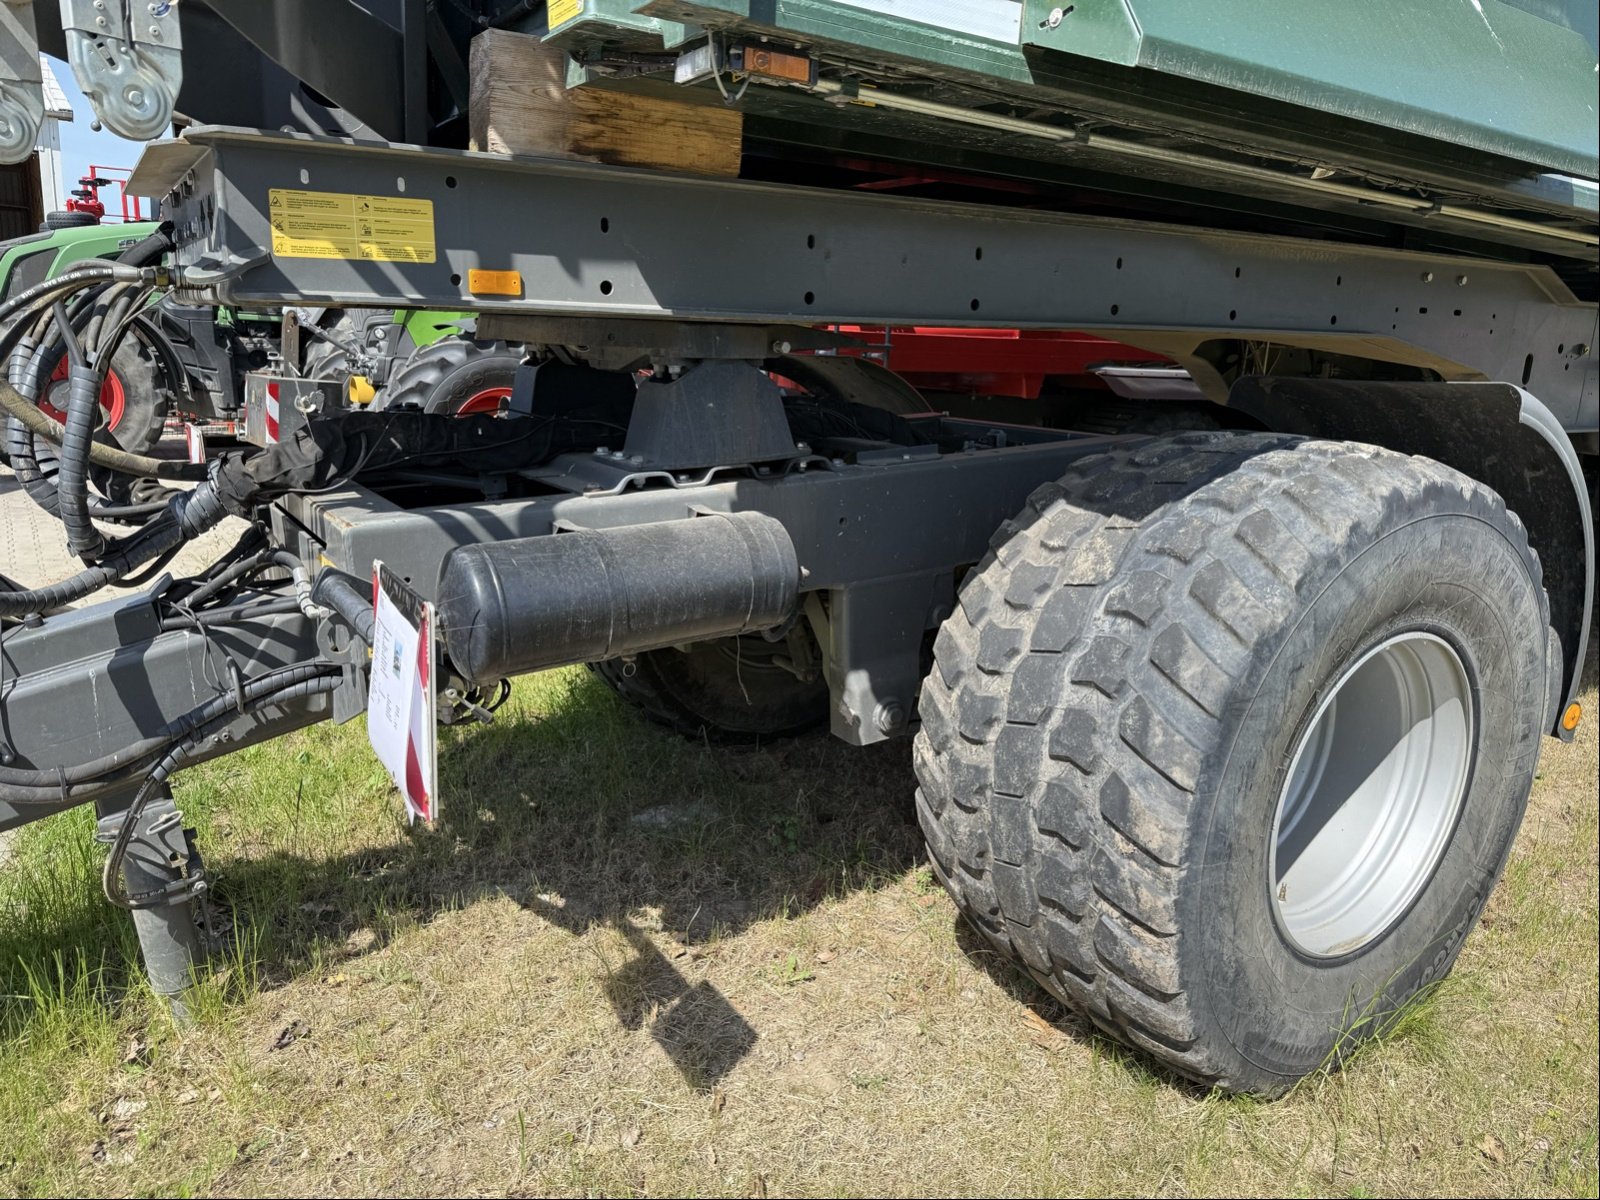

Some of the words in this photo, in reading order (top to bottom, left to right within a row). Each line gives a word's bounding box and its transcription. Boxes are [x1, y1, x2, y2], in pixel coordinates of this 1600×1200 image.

[57, 275, 70, 283] 330
[70, 272, 81, 280] WP
[43, 280, 57, 288] BAR
